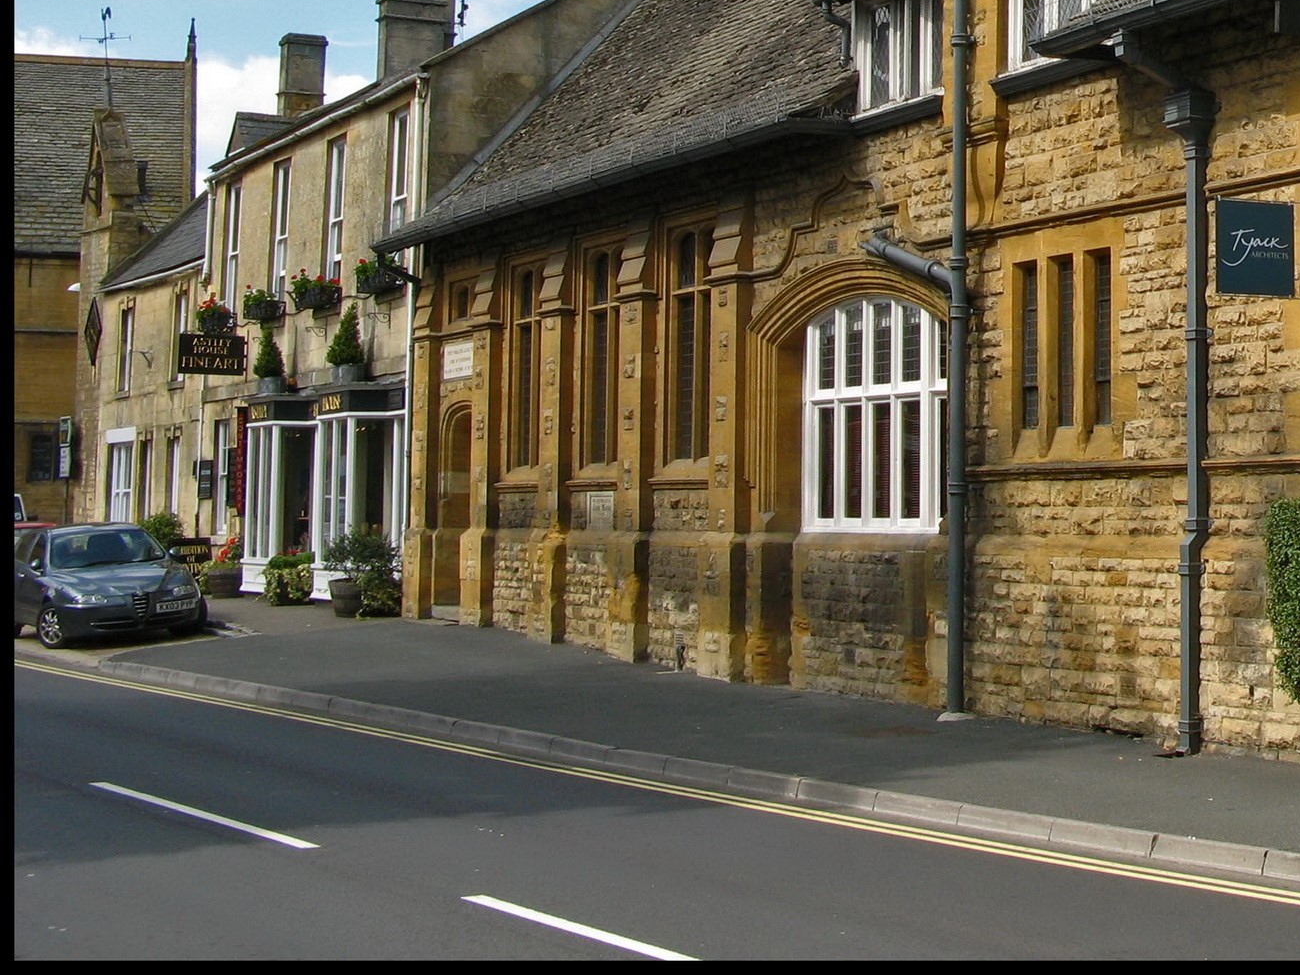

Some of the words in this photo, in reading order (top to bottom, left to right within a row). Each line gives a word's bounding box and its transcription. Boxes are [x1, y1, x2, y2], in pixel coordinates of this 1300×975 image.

[1220, 228, 1289, 266] Tyack
[1251, 251, 1290, 260] ARCHITECTS
[192, 337, 232, 347] ASTLEY
[193, 345, 229, 355] HOUSE
[181, 356, 211, 368] FINE
[213, 357, 239, 370] ART
